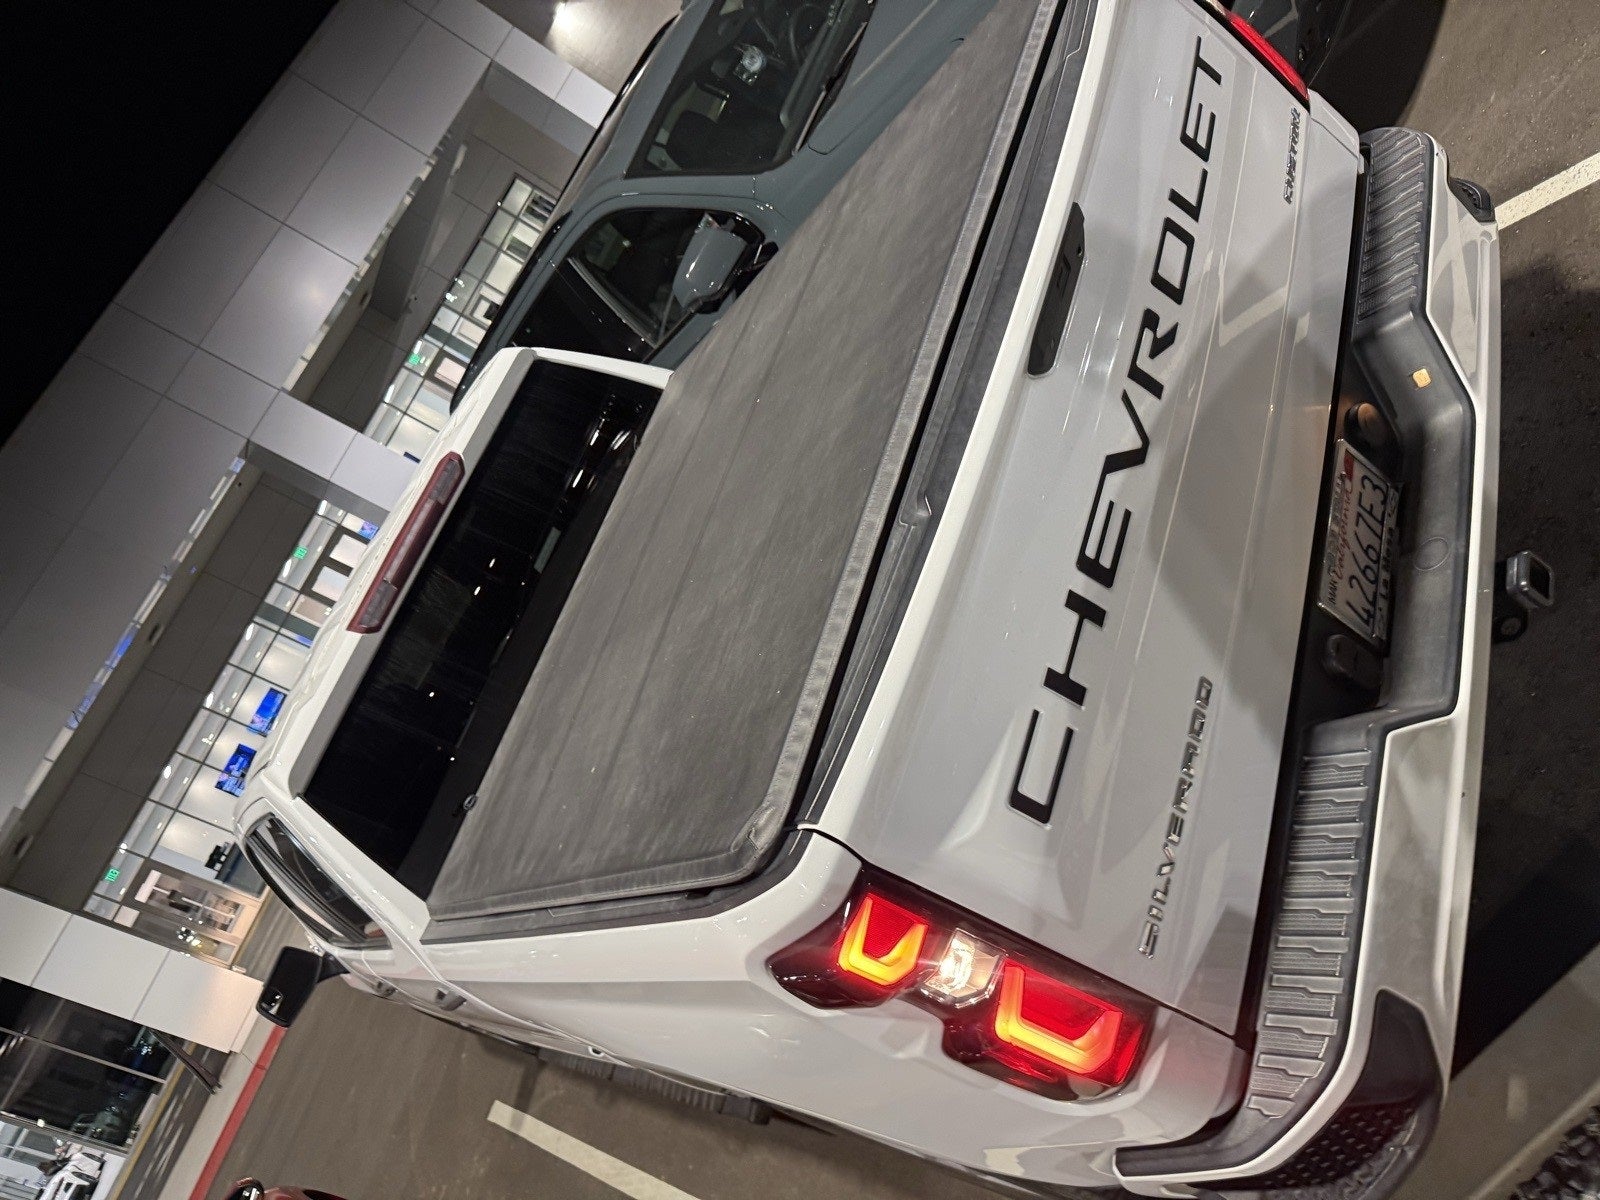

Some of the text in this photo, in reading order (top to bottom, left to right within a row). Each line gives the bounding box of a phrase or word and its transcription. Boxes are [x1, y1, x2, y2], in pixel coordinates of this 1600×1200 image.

[1008, 36, 1227, 824] CHEVROLET
[1347, 474, 1387, 628] 42667E3
[1138, 675, 1213, 959] SILVERADO
